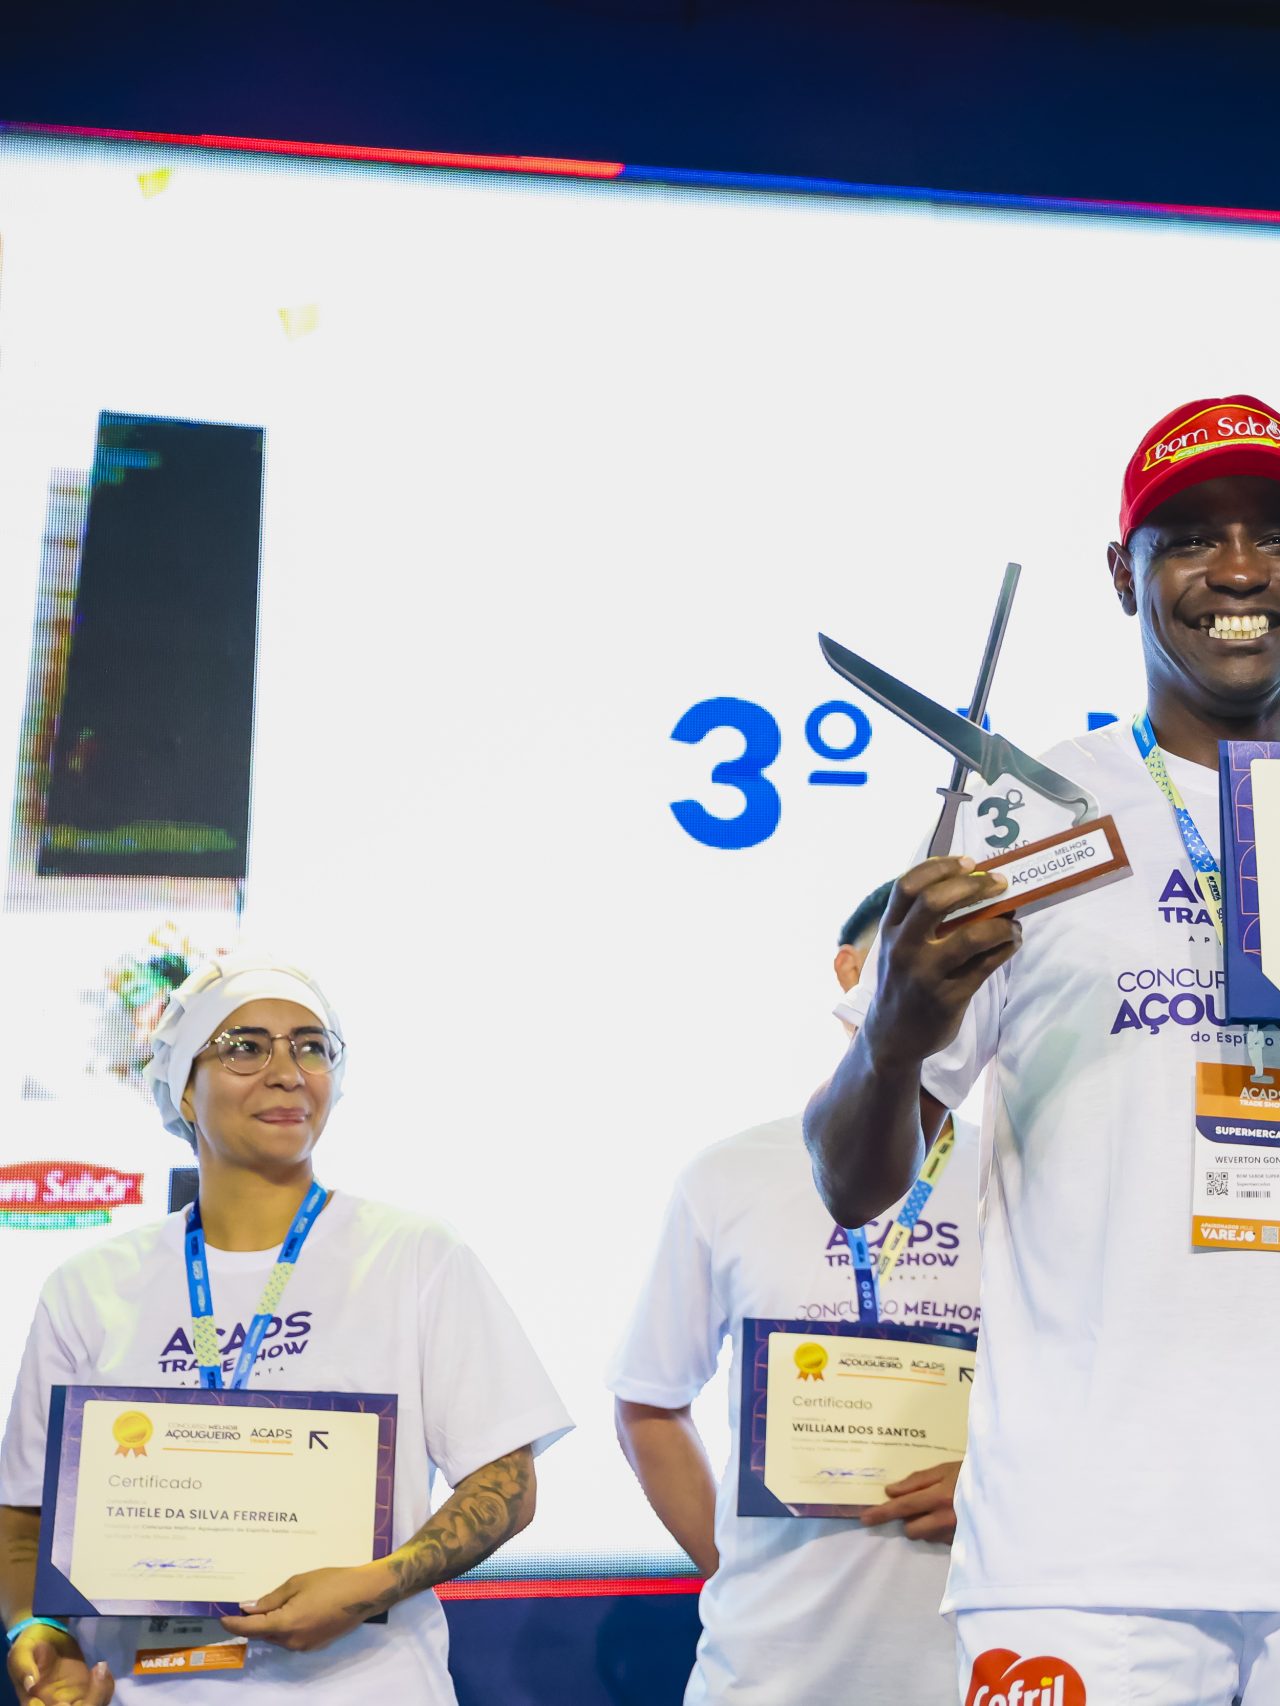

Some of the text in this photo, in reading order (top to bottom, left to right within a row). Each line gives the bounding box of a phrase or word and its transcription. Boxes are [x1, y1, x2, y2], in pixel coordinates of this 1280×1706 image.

[1154, 427, 1209, 460] Bom
[1054, 839, 1089, 856] MELHOR
[1011, 846, 1096, 885] AÇOUGUEIRO
[1158, 906, 1215, 927] TRA
[1190, 1031, 1211, 1042] do
[1216, 1032, 1275, 1047] Espío
[1239, 1099, 1264, 1108] TRADE
[1215, 1156, 1261, 1164] WEVERTON
[838, 1358, 903, 1369] AÇOUGUEIRO
[911, 1360, 945, 1371] ACAPS
[792, 1395, 873, 1410] Certificado
[165, 1429, 241, 1441] AÇOUGUEIRO
[250, 1428, 293, 1439] ACAPS
[792, 1423, 927, 1438] WILLIAM DOS SANTOS
[108, 1474, 203, 1490] Certificado
[106, 1506, 299, 1523] TATIELE DA SILVA FERREIRA
